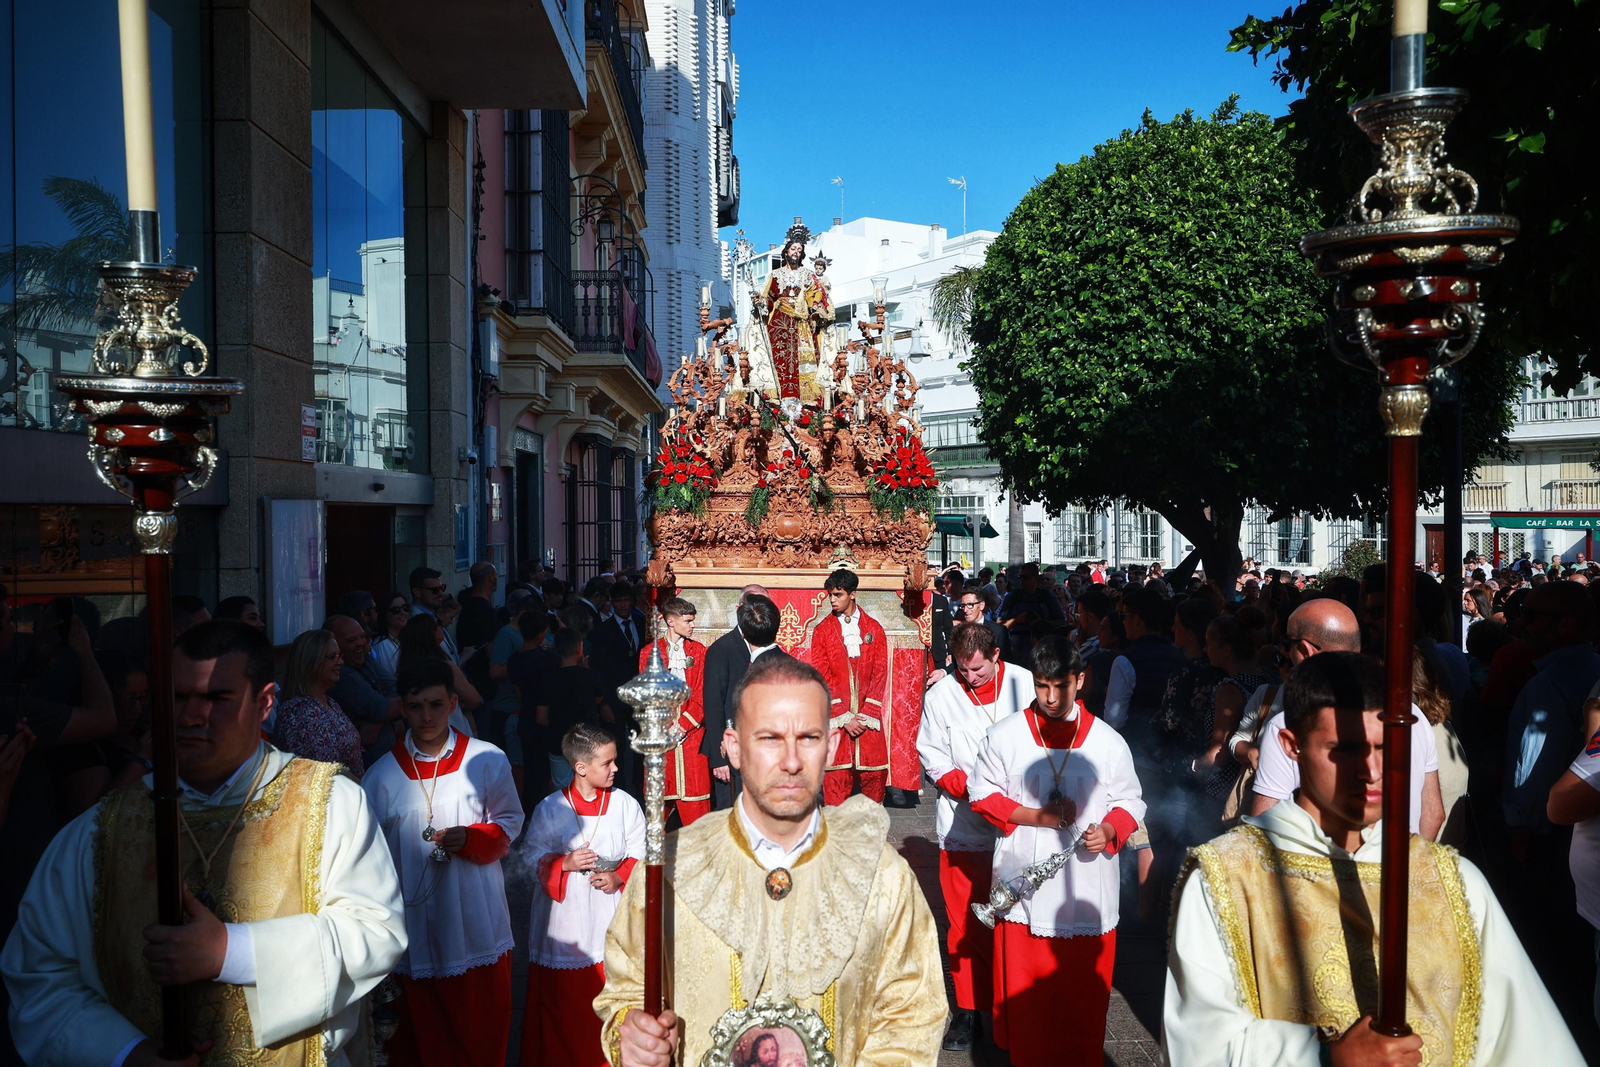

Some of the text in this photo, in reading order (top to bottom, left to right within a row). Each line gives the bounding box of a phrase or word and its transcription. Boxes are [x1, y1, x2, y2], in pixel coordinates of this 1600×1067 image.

[1526, 518, 1547, 527] CAFÉ
[1556, 519, 1574, 527] BAR
[1579, 519, 1591, 527] LA
